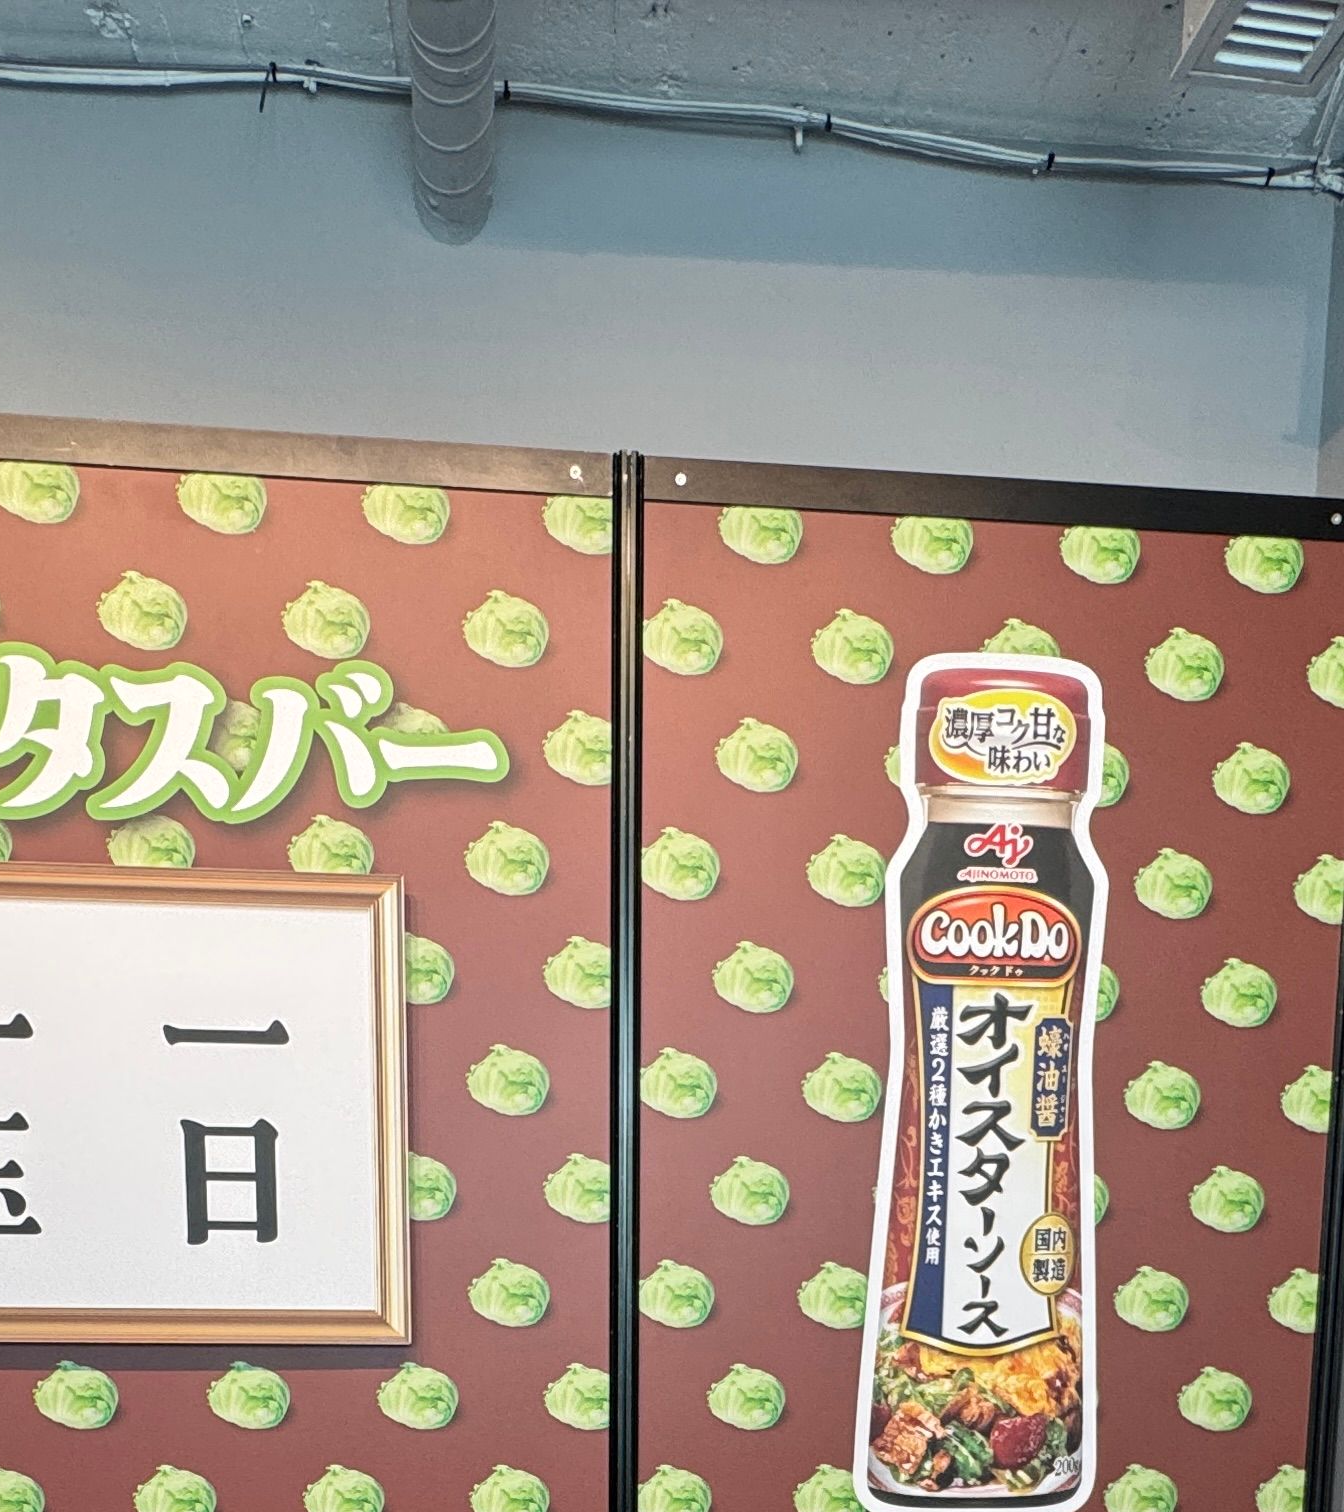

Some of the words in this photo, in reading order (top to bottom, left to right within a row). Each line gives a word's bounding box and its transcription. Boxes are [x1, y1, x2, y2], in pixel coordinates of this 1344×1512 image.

[987, 745, 1051, 775] 味わい
[959, 868, 1035, 881] AJINOMOTO
[162, 1018, 291, 1246] 一日
[924, 1005, 950, 1265] 厳選2種かきエキス使用
[955, 991, 1034, 1337] オイスターソース
[1034, 1226, 1067, 1253] 国内
[1031, 1257, 1066, 1283] 製造
